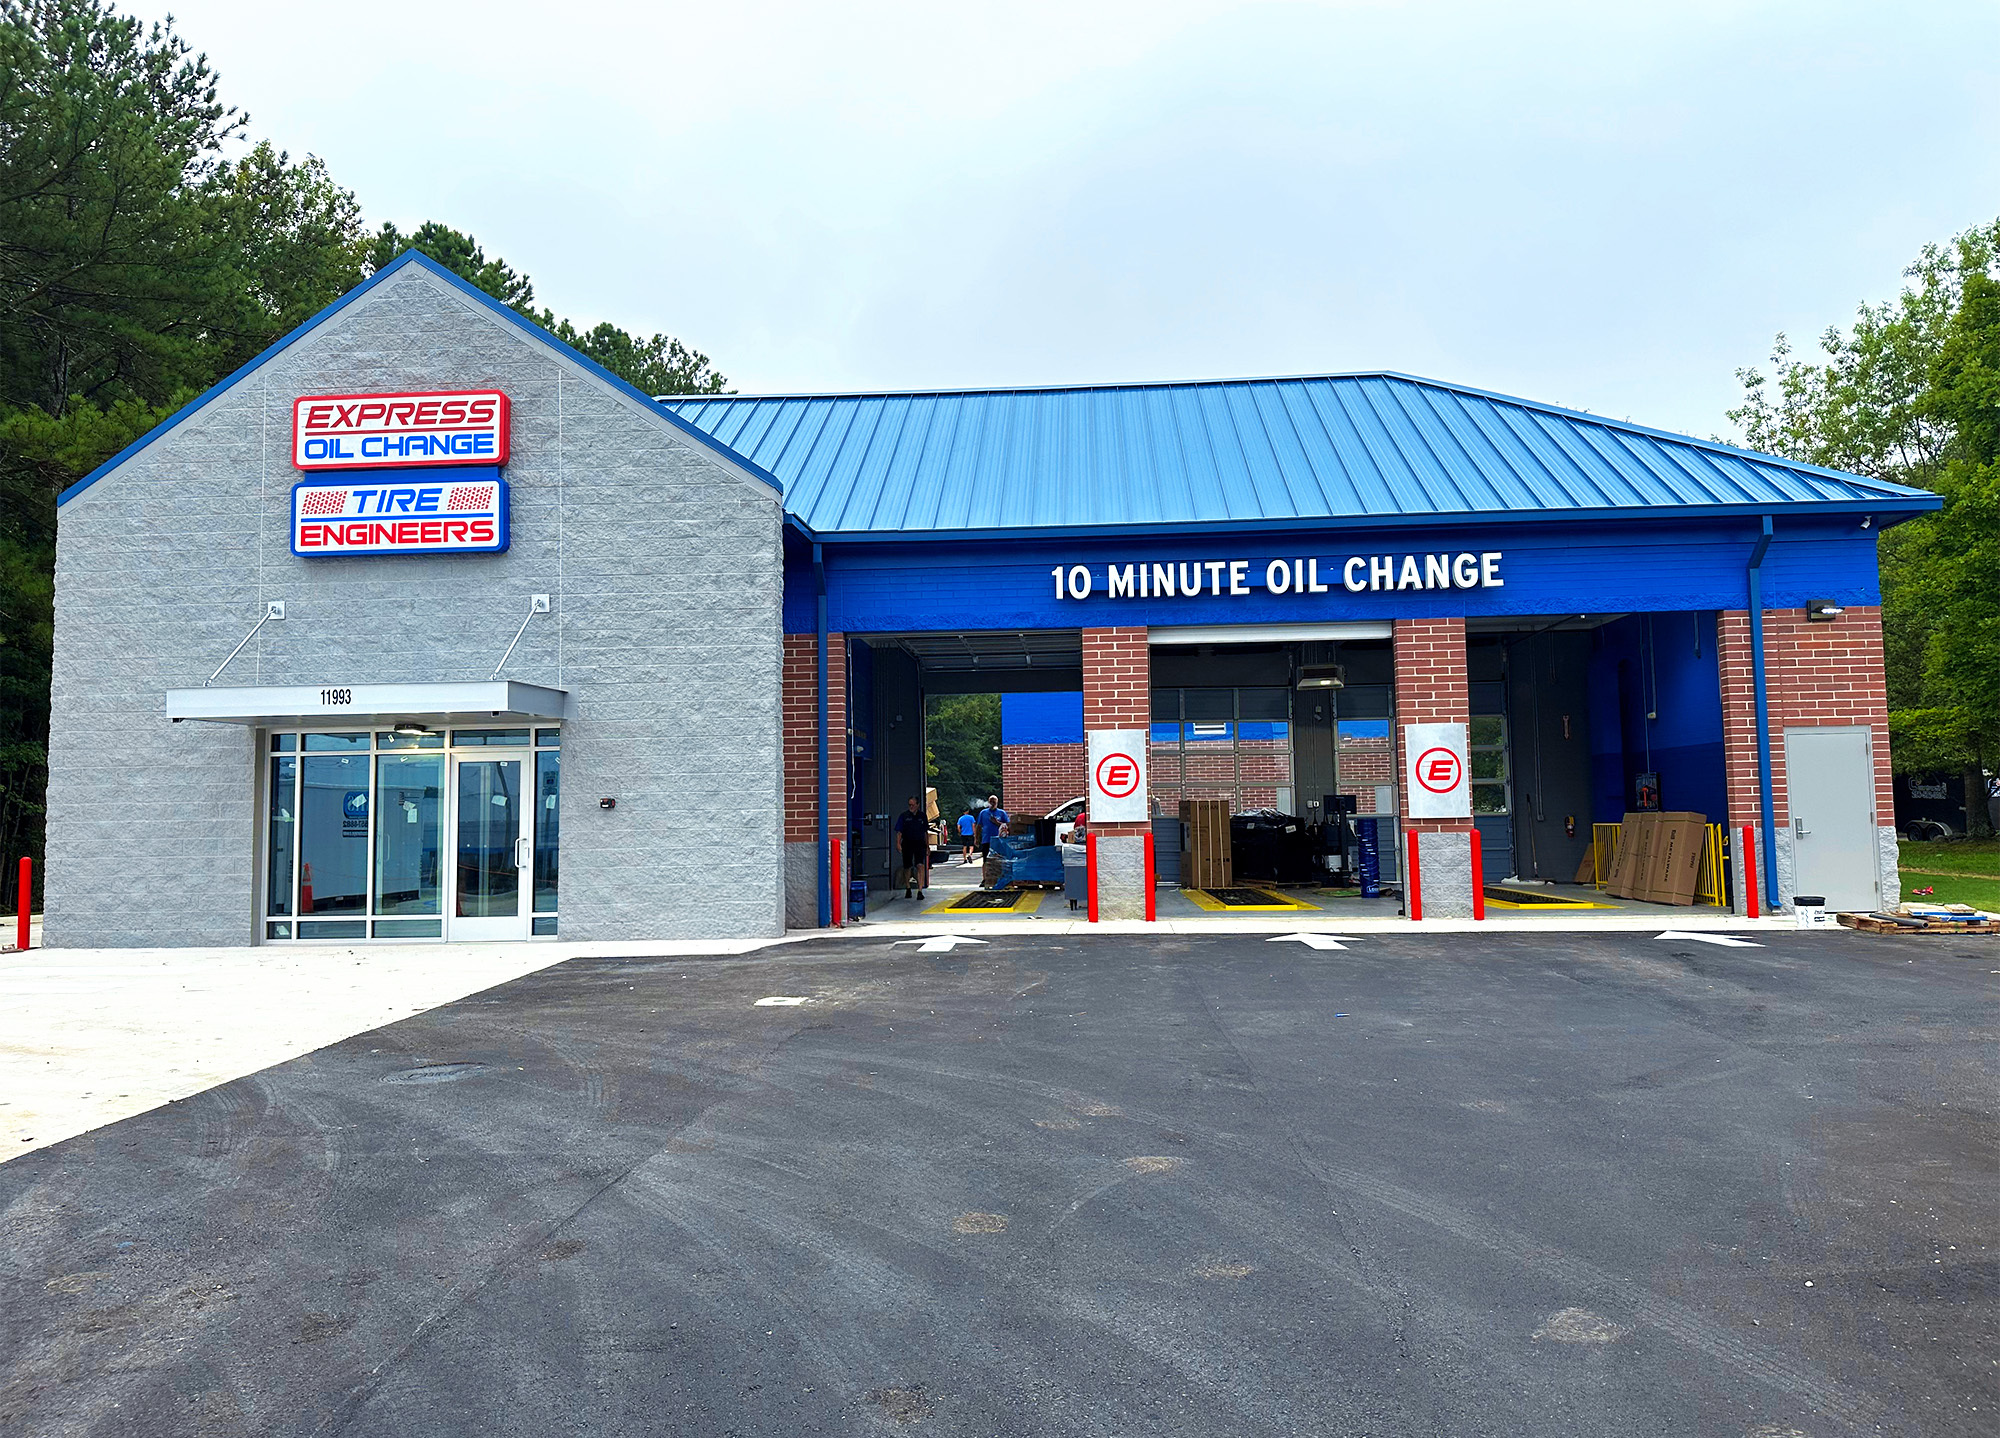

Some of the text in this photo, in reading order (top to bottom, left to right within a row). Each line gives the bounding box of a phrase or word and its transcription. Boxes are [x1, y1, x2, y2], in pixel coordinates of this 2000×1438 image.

[305, 400, 497, 429] EXPRESS
[304, 433, 494, 459] OIL CHANGE
[352, 488, 443, 513] TIRE
[300, 520, 494, 547] ENGINEERS
[1051, 552, 1504, 599] 10 MINUTE OIL CHANGE
[321, 689, 351, 705] 11993
[1106, 765, 1131, 785] E
[1427, 759, 1453, 780] E
